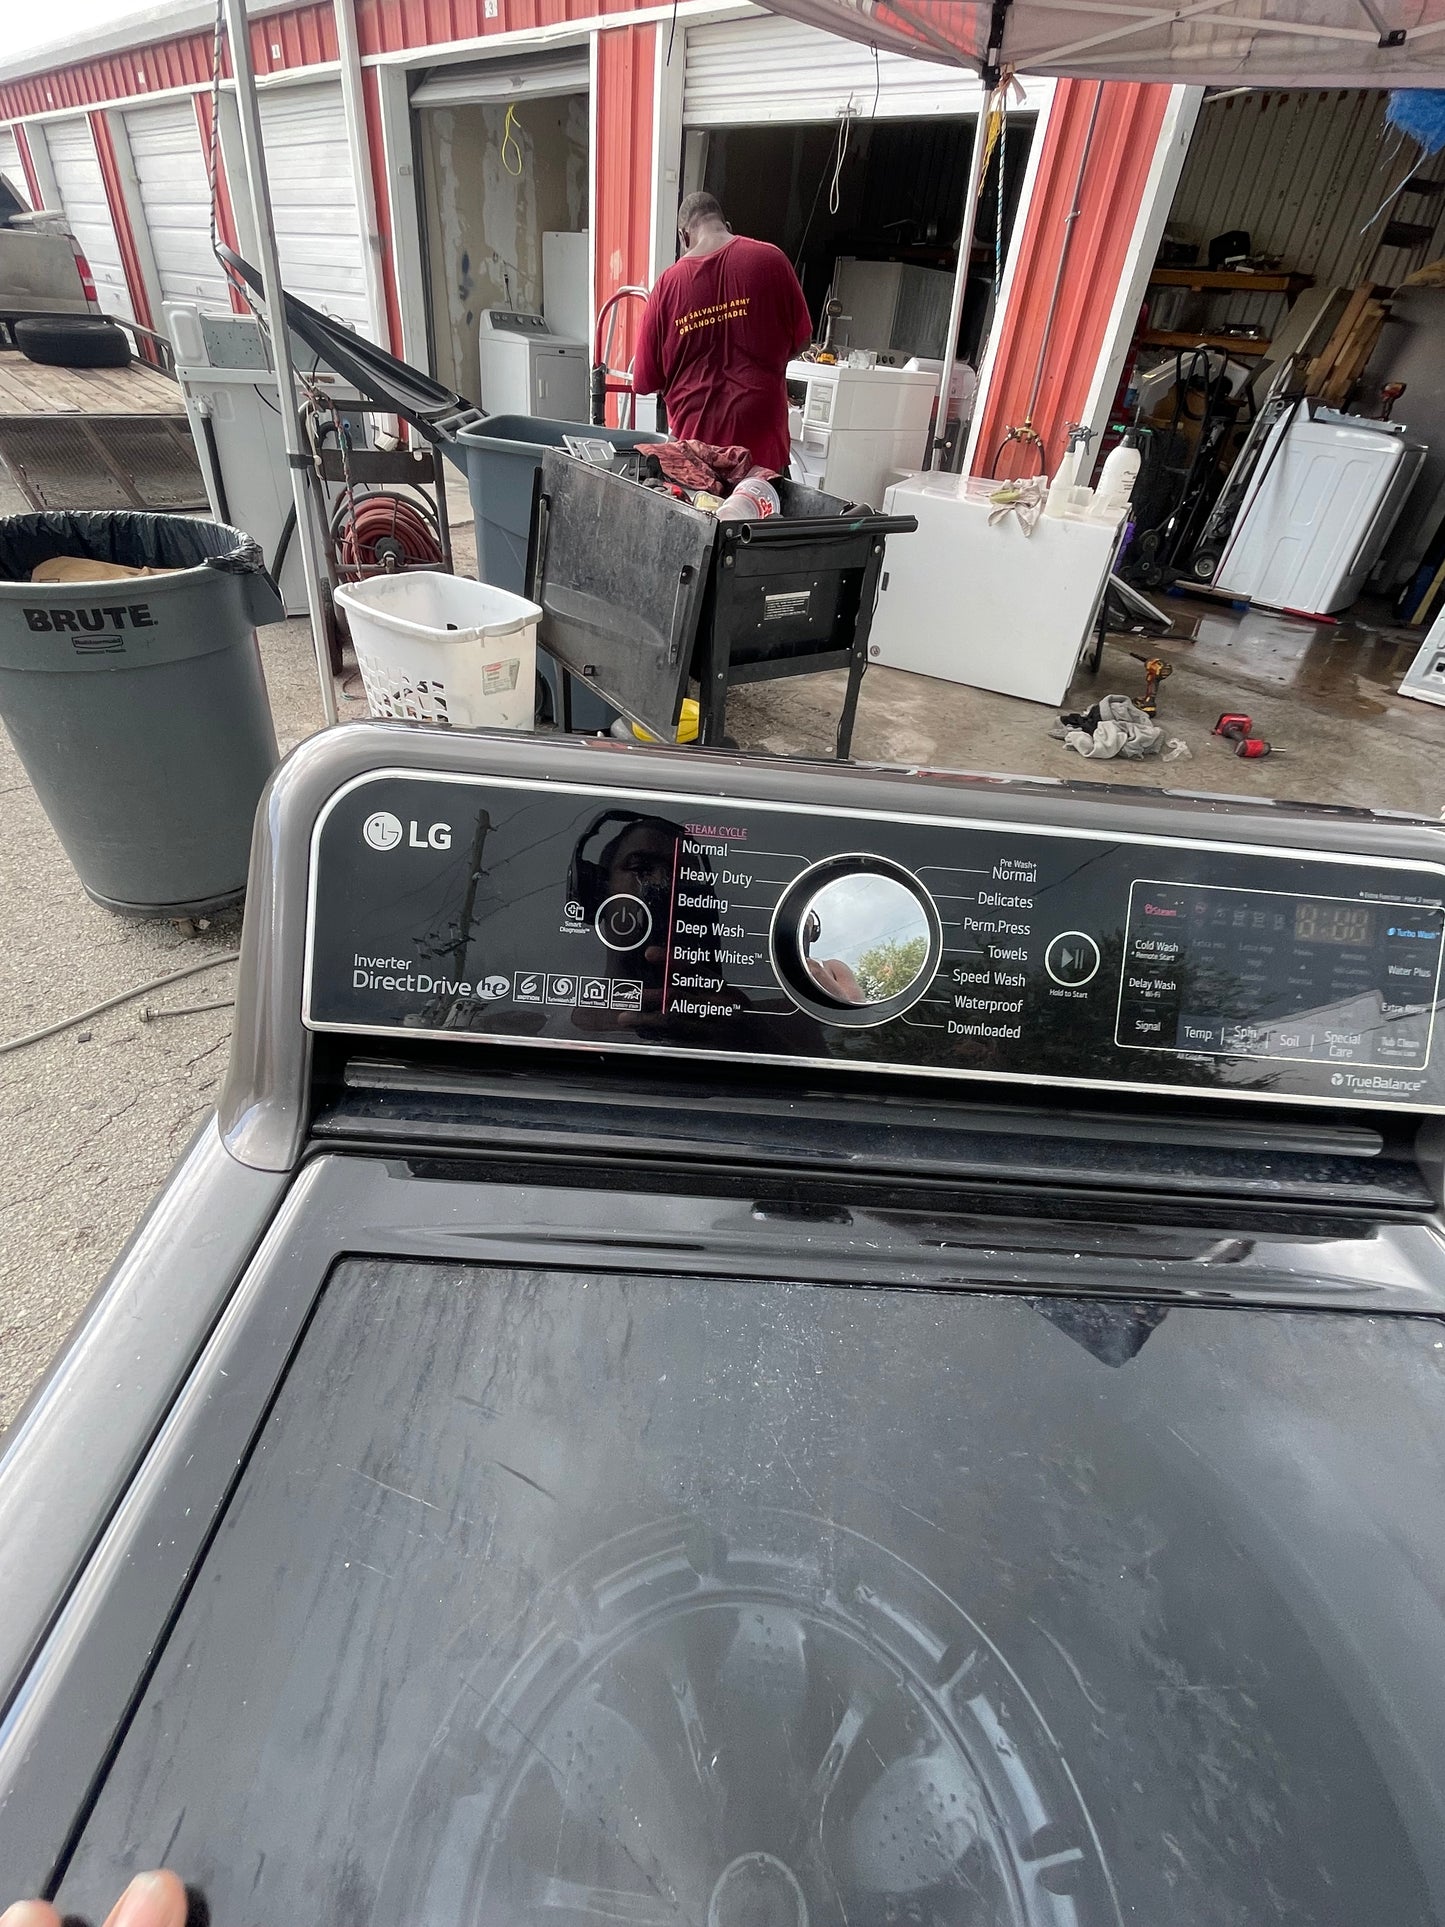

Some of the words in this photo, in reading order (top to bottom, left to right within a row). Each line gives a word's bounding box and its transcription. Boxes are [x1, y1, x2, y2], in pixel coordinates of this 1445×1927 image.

[675, 315, 688, 327] THE
[689, 302, 728, 320] SALVATION
[730, 297, 750, 307] ARMY
[679, 317, 716, 335] ORLANDO
[717, 308, 748, 322] CITADEL
[408, 820, 452, 850] LG
[684, 823, 716, 835] STEAM
[718, 827, 748, 838] CYCLE
[682, 839, 728, 857] Normal
[999, 858, 1012, 868] Pre
[680, 866, 719, 886] Heavy
[722, 870, 753, 889] Duty
[992, 866, 1037, 883] Normal
[677, 893, 729, 914] Bedding
[977, 891, 1034, 909] Delicates
[564, 920, 582, 928] Smart
[675, 919, 708, 938] Deep
[711, 922, 745, 938] Wash
[1396, 928, 1417, 938] Turbo
[987, 945, 1028, 961] Towels
[1135, 939, 1155, 951] Cold
[1156, 941, 1179, 952] Wash
[354, 953, 412, 970] Inverter
[673, 946, 711, 965] Bright
[1135, 951, 1159, 960] Remote
[1159, 953, 1175, 961] Start
[952, 968, 990, 985] Speed
[993, 972, 1026, 987] Wash
[1388, 965, 1413, 976] Water
[1413, 967, 1432, 978] Plus
[671, 972, 725, 993] Sanitary
[1129, 977, 1153, 990] Delay
[1154, 980, 1177, 990] Wash
[1049, 988, 1064, 997] Hold
[1072, 991, 1088, 999] Start
[954, 994, 1024, 1013] Waterproof
[1381, 1002, 1404, 1013] Extra
[947, 1020, 1022, 1039] Downloaded
[1135, 1020, 1161, 1033] Signal
[1184, 1025, 1215, 1042] Temp.
[1233, 1025, 1258, 1041] Spin
[1279, 1034, 1301, 1048] Soil
[1323, 1030, 1361, 1046] Special
[1381, 1036, 1396, 1047] Tub
[1396, 1038, 1420, 1048] Clean
[1328, 1045, 1353, 1059] Care
